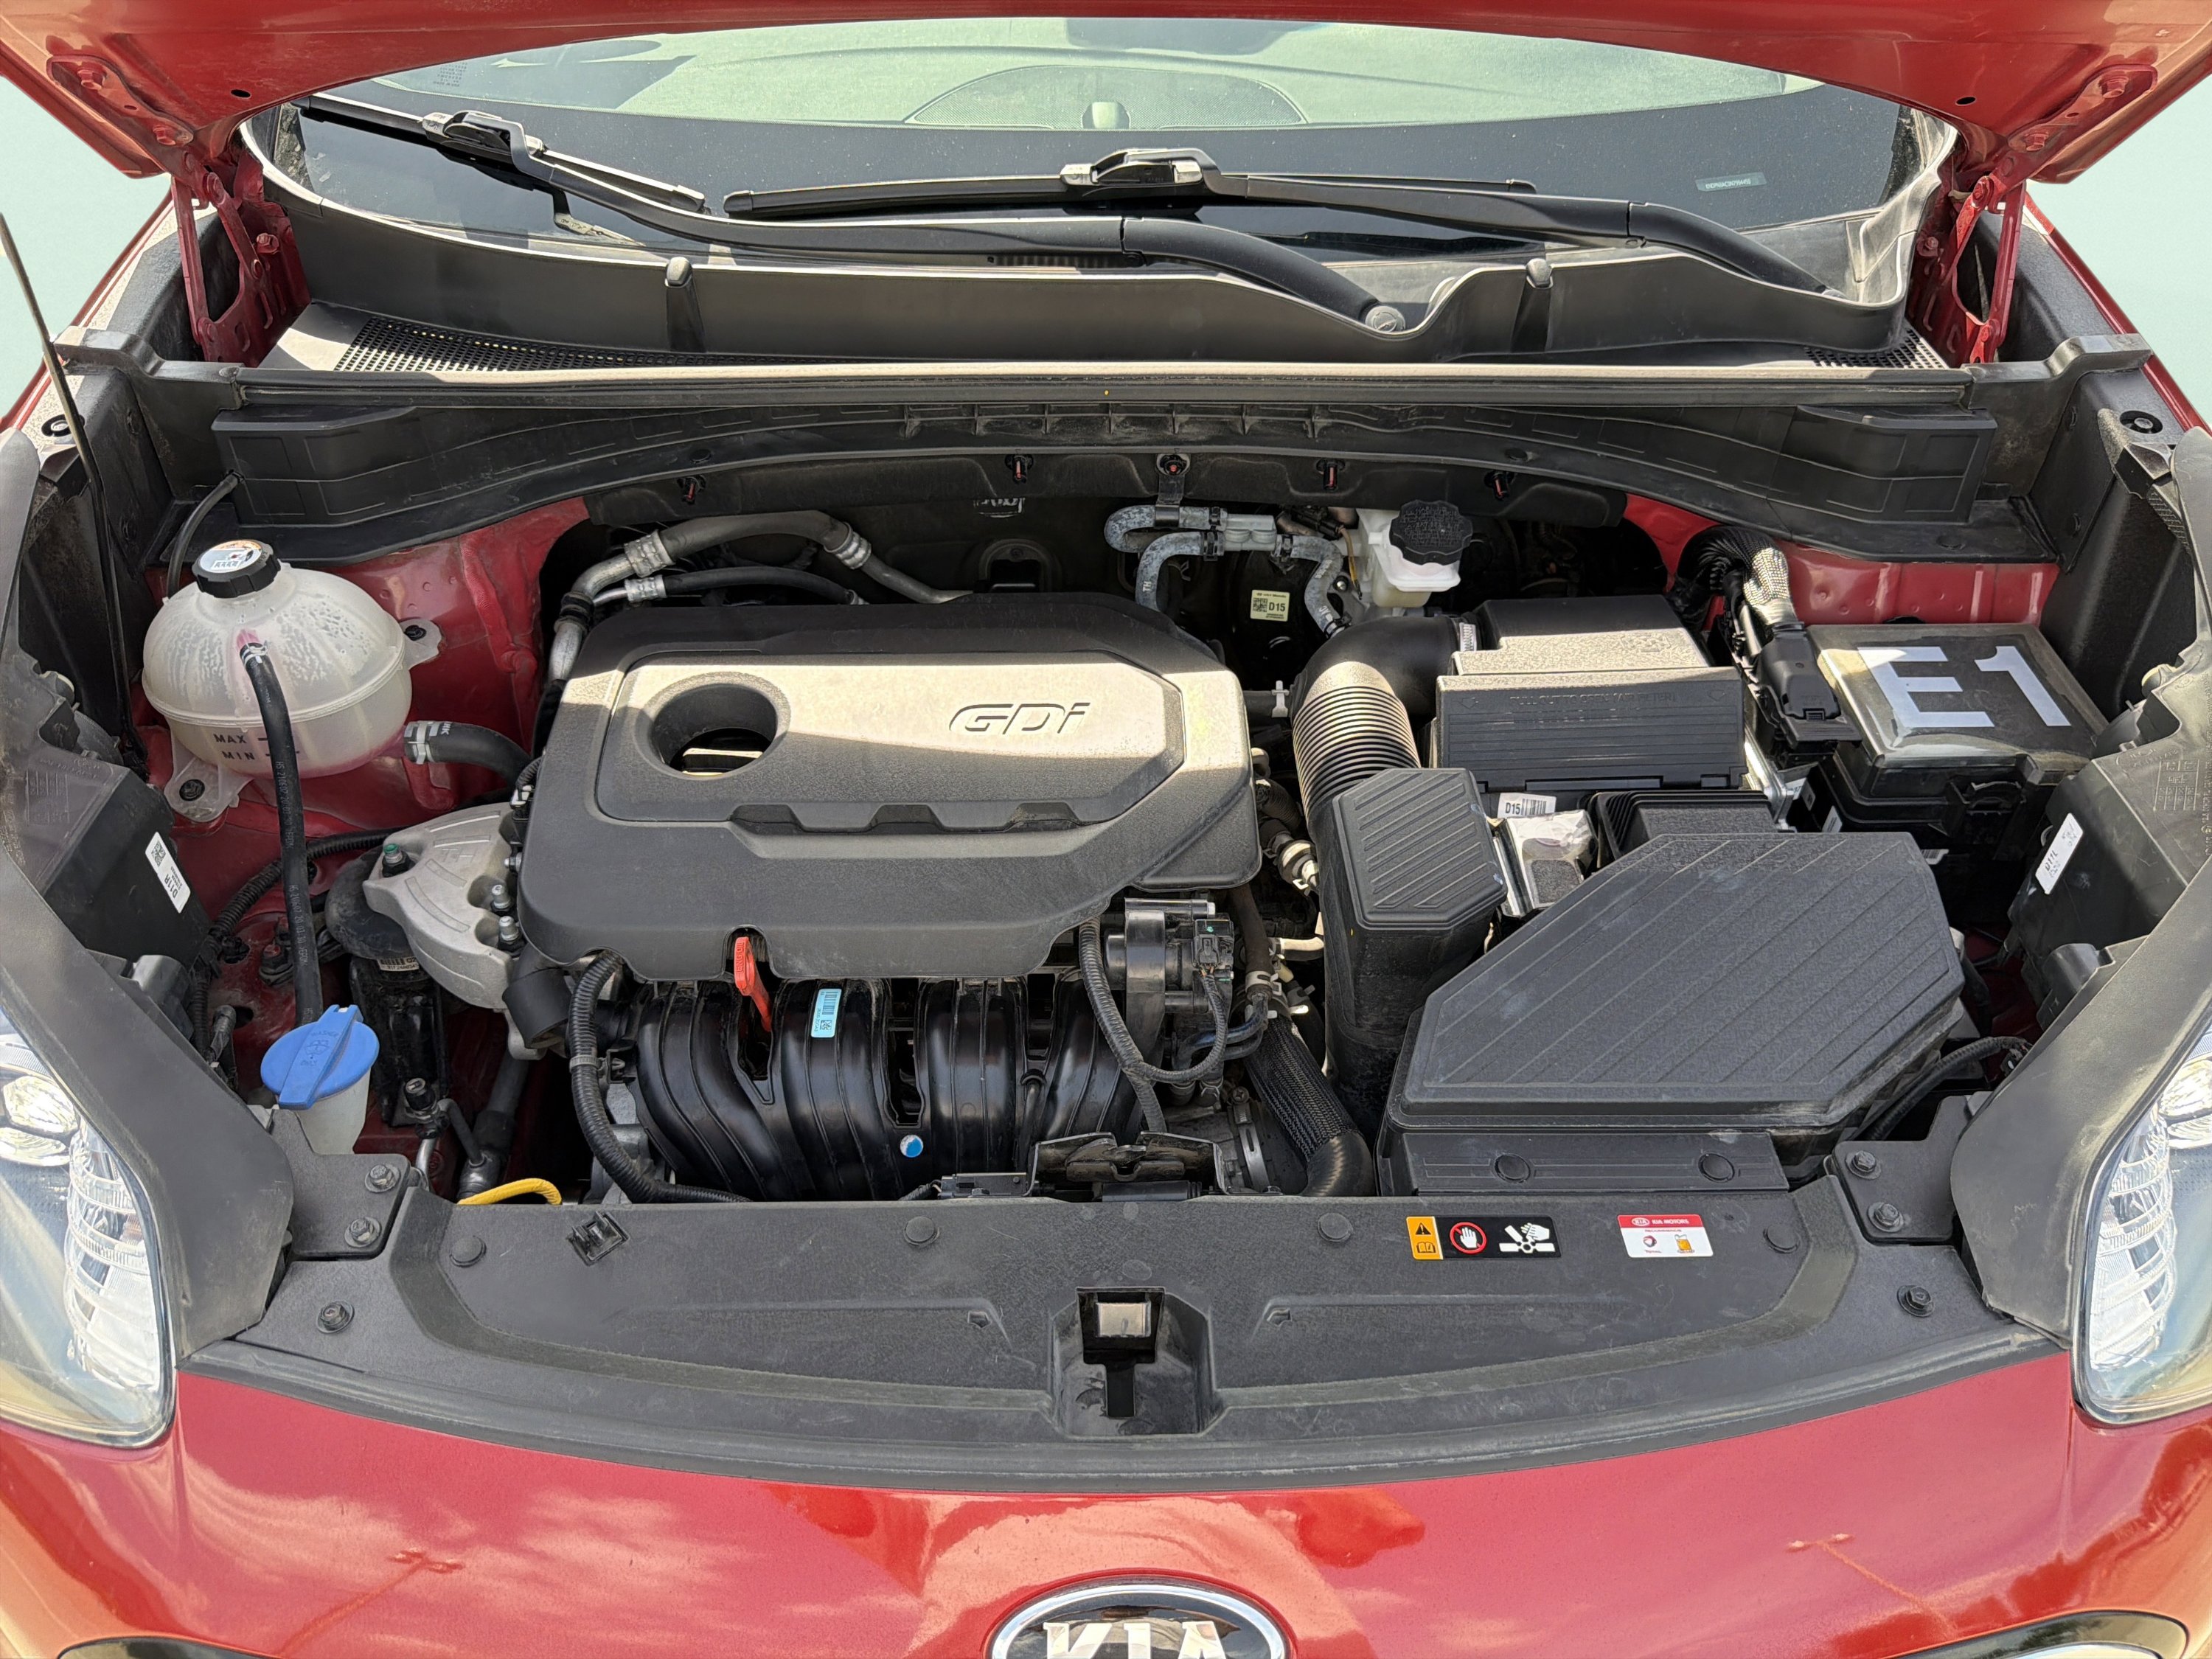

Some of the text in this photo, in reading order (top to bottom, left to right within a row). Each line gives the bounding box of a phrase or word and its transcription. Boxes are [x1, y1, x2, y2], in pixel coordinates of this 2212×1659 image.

[1268, 602, 1286, 612] D15
[1857, 646, 2071, 728] E1
[213, 734, 247, 744] MAX
[221, 751, 255, 760] MIN
[1505, 802, 1520, 815] D15
[164, 874, 178, 898] D11R
[736, 953, 745, 974] ENG
